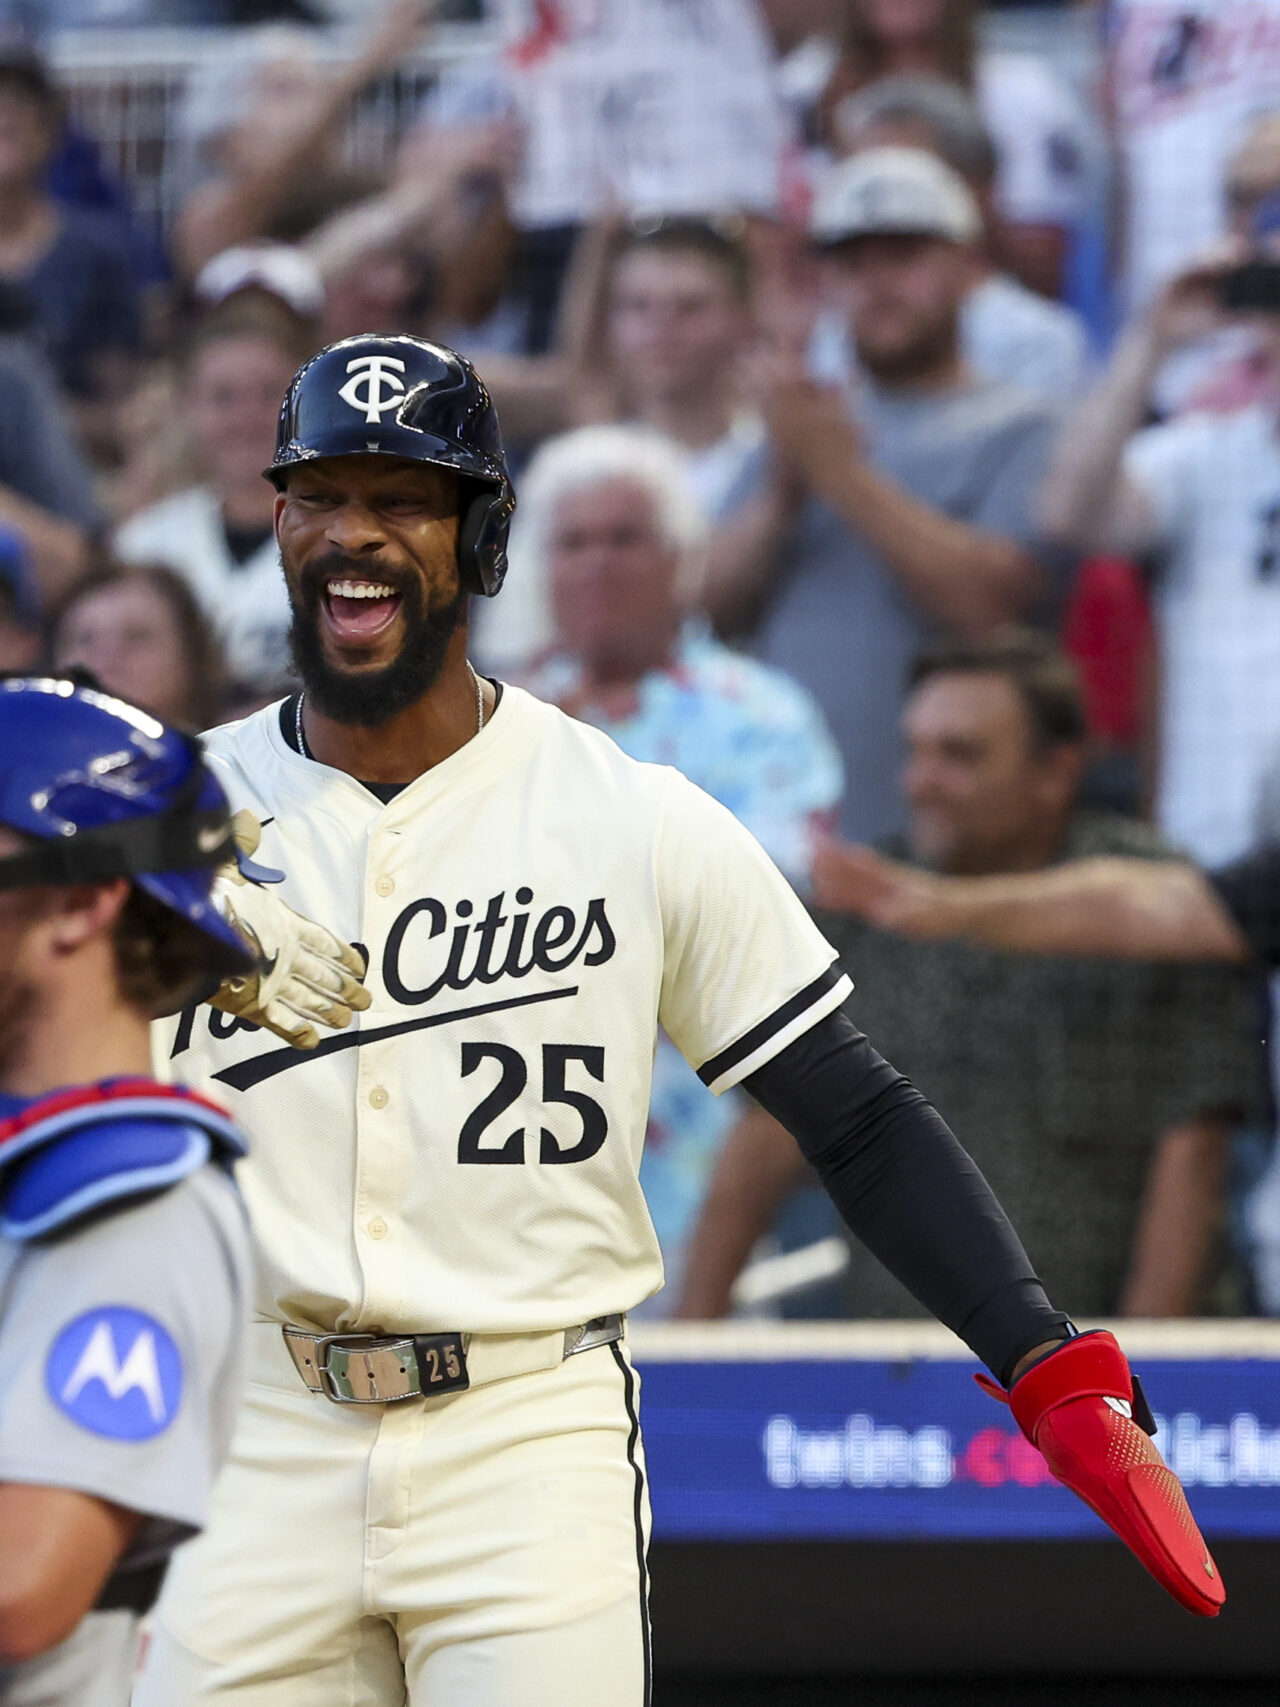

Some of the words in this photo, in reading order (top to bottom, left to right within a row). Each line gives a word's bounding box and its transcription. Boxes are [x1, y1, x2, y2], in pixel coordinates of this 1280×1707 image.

[382, 887, 616, 1005] Cities
[457, 1041, 608, 1165] 25
[426, 1344, 461, 1383] 25
